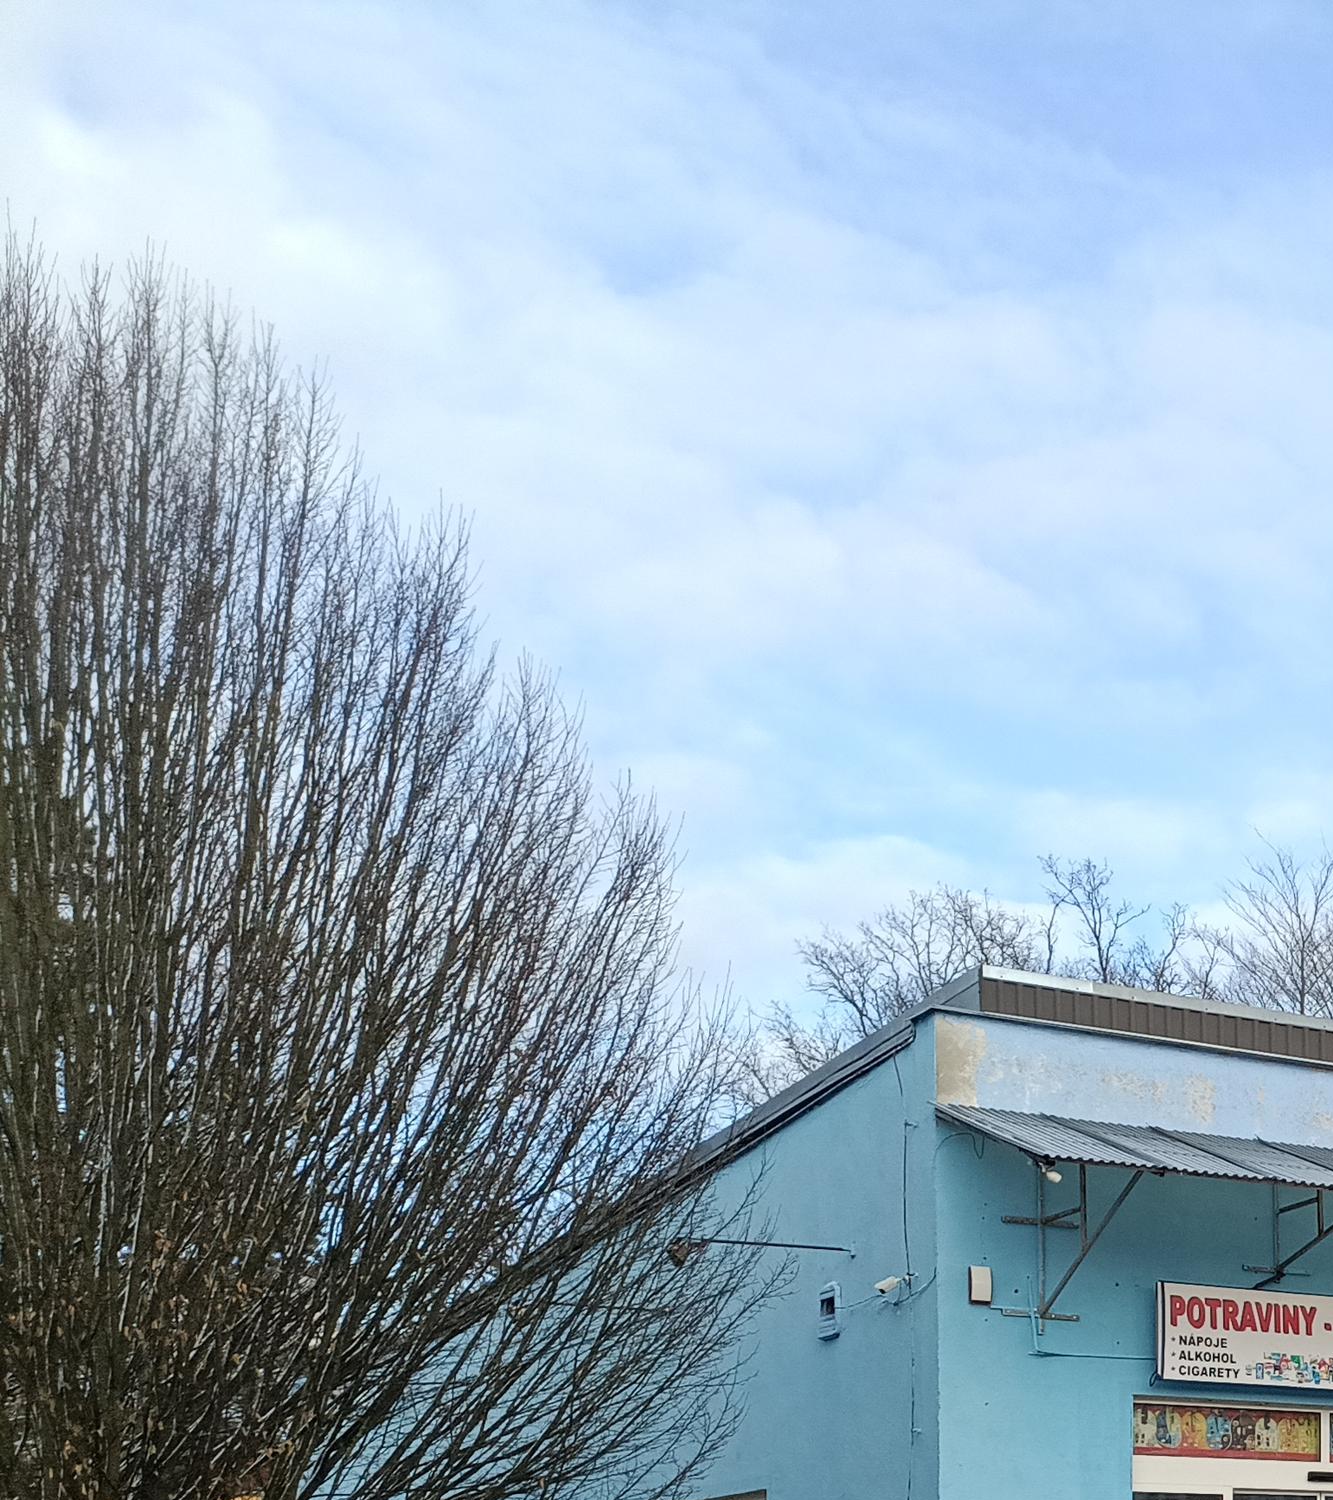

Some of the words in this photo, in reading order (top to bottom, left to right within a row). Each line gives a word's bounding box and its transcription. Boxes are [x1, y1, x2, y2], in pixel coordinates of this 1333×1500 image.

[1169, 1294, 1317, 1336] POTRAVINY
[1178, 1333, 1228, 1349] NÁPOJE
[1178, 1350, 1237, 1364] ALKOHOL
[1178, 1365, 1241, 1379] CIGARETY
